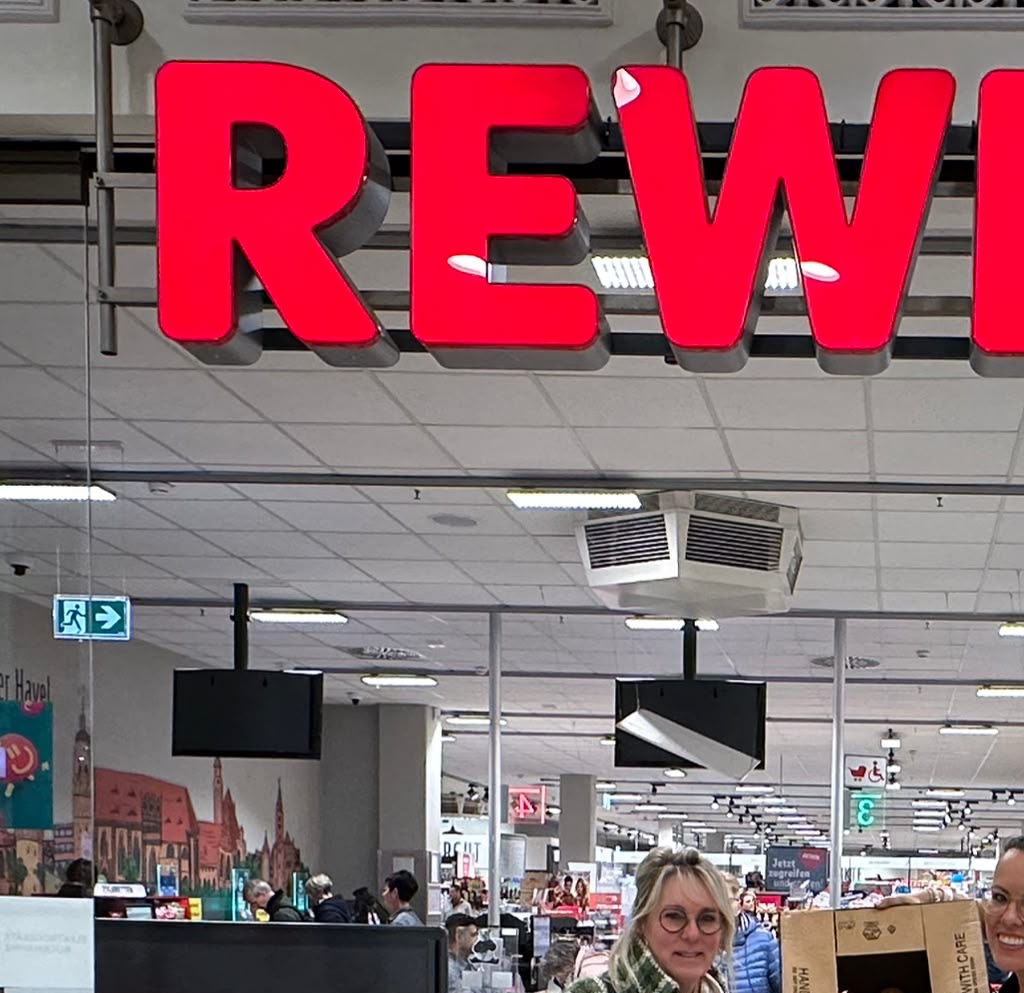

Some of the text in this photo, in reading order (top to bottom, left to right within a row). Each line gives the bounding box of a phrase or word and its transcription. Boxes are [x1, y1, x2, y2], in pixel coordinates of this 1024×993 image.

[15, 668, 50, 703] Havel
[772, 858, 796, 868] Jetzt
[954, 932, 969, 963] CARE
[959, 966, 972, 993] WITH
